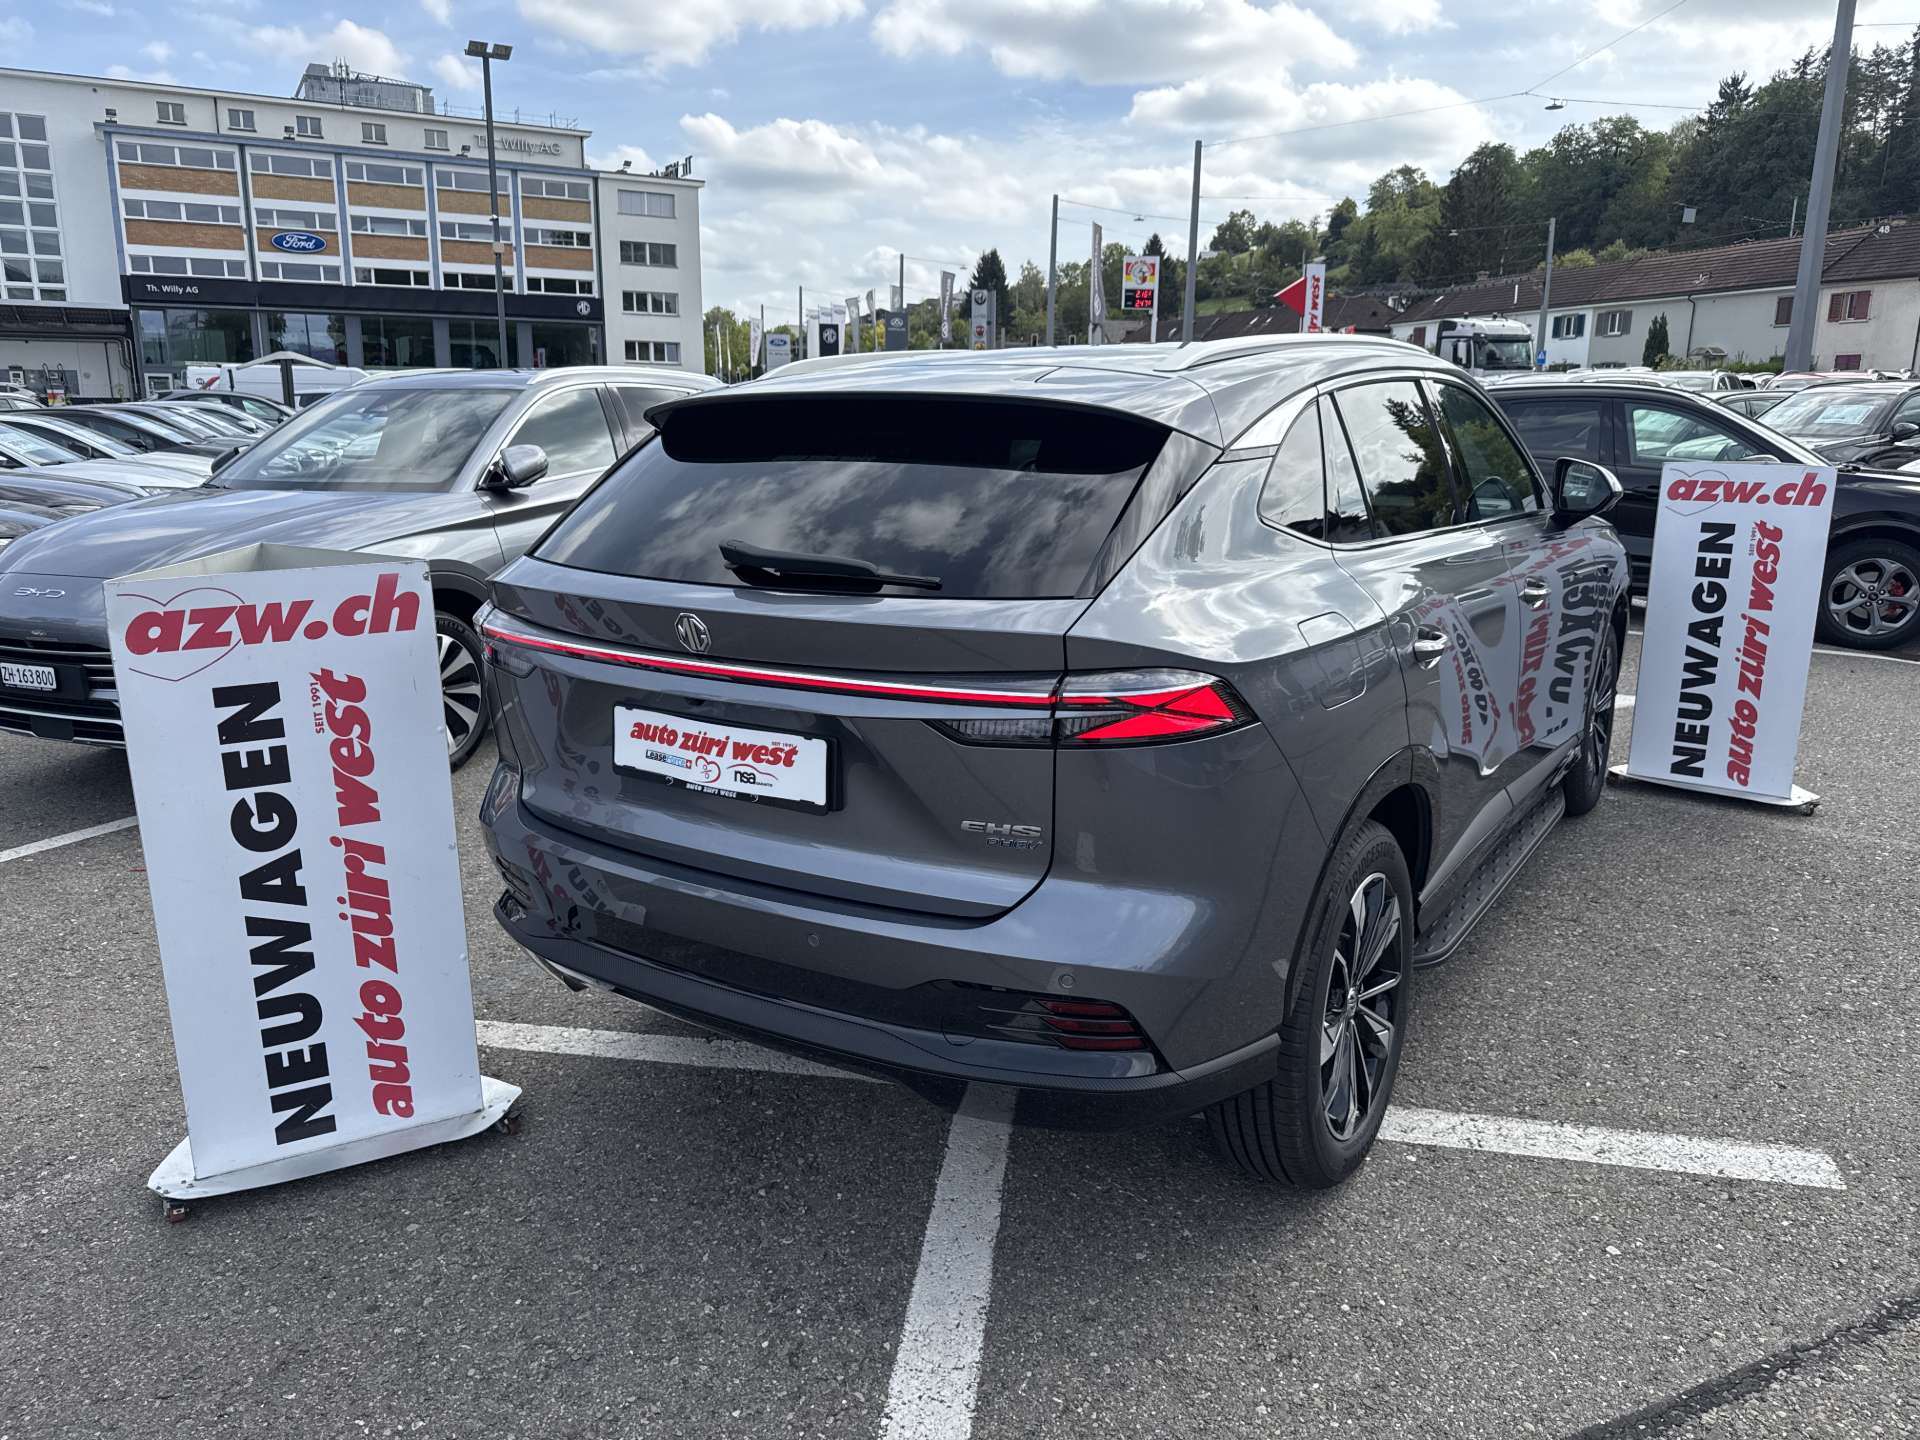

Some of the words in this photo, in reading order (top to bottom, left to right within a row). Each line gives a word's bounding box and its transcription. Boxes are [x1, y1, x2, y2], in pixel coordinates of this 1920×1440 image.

[502, 138, 536, 155] Willy
[540, 143, 563, 156] AG
[283, 234, 316, 250] Ford
[146, 284, 160, 293] Th.
[162, 285, 184, 295] Willy
[186, 286, 199, 294] AG
[1667, 471, 1828, 506] azw.ch
[1749, 519, 1783, 611] west
[13, 587, 66, 598] BYD
[124, 574, 421, 656] azw.ch
[676, 614, 710, 654] MG
[1670, 522, 1737, 779] NEUWAGEN
[1735, 613, 1769, 698] züri
[310, 682, 321, 707] 1991
[313, 711, 325, 734] SEIT
[1726, 698, 1758, 786] auto
[309, 667, 380, 826] west
[630, 721, 679, 747] auto
[679, 731, 730, 758] züri
[732, 741, 799, 768] west
[685, 782, 703, 792] auto
[719, 789, 738, 799] west
[734, 770, 757, 785] nsa
[960, 820, 1042, 838] EHS
[212, 680, 337, 1147] NEUWAGEN
[330, 836, 398, 972] züri
[353, 979, 413, 1117] auto
